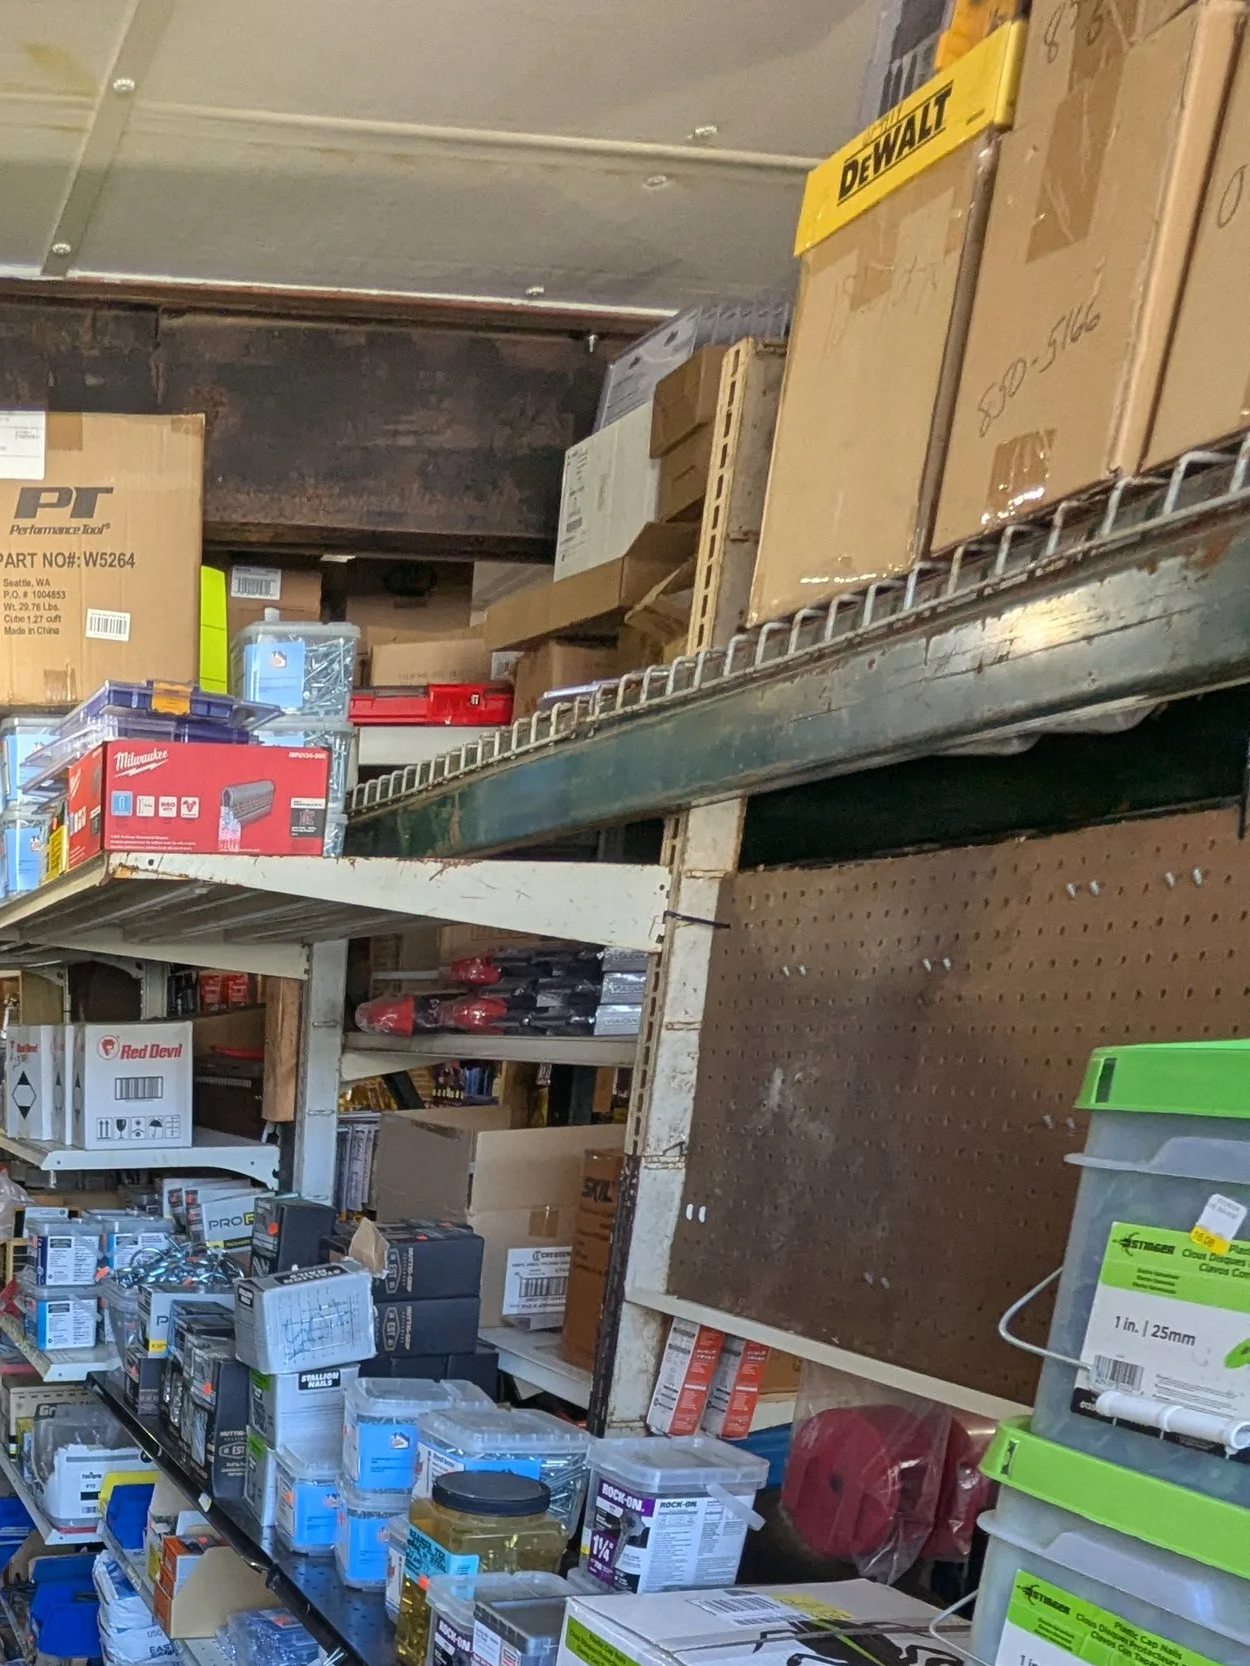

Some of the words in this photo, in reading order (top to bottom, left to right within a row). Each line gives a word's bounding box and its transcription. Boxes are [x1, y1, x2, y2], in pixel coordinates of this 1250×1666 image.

[14, 486, 114, 519] PT
[9, 524, 81, 536] Performance
[83, 552, 136, 568] W5264
[3, 578, 34, 588] Seattle,
[36, 579, 51, 587] WA
[32, 591, 66, 600] 1004853
[4, 615, 25, 623] Cube
[4, 627, 26, 635] Made
[28, 627, 36, 635] in
[37, 627, 60, 635] China
[113, 748, 170, 772] Milwaukee
[120, 1045, 149, 1060] Red
[150, 1044, 182, 1058] Devil
[1115, 1316, 1121, 1329] 1
[1123, 1318, 1139, 1333] in.
[1151, 1324, 1197, 1346] 25mm
[301, 1372, 339, 1382] STALLION
[308, 1381, 333, 1389] NAILS
[659, 1501, 697, 1509] ROCK-ON
[1140, 1634, 1159, 1650] Cap
[1019, 1654, 1025, 1666] 1
